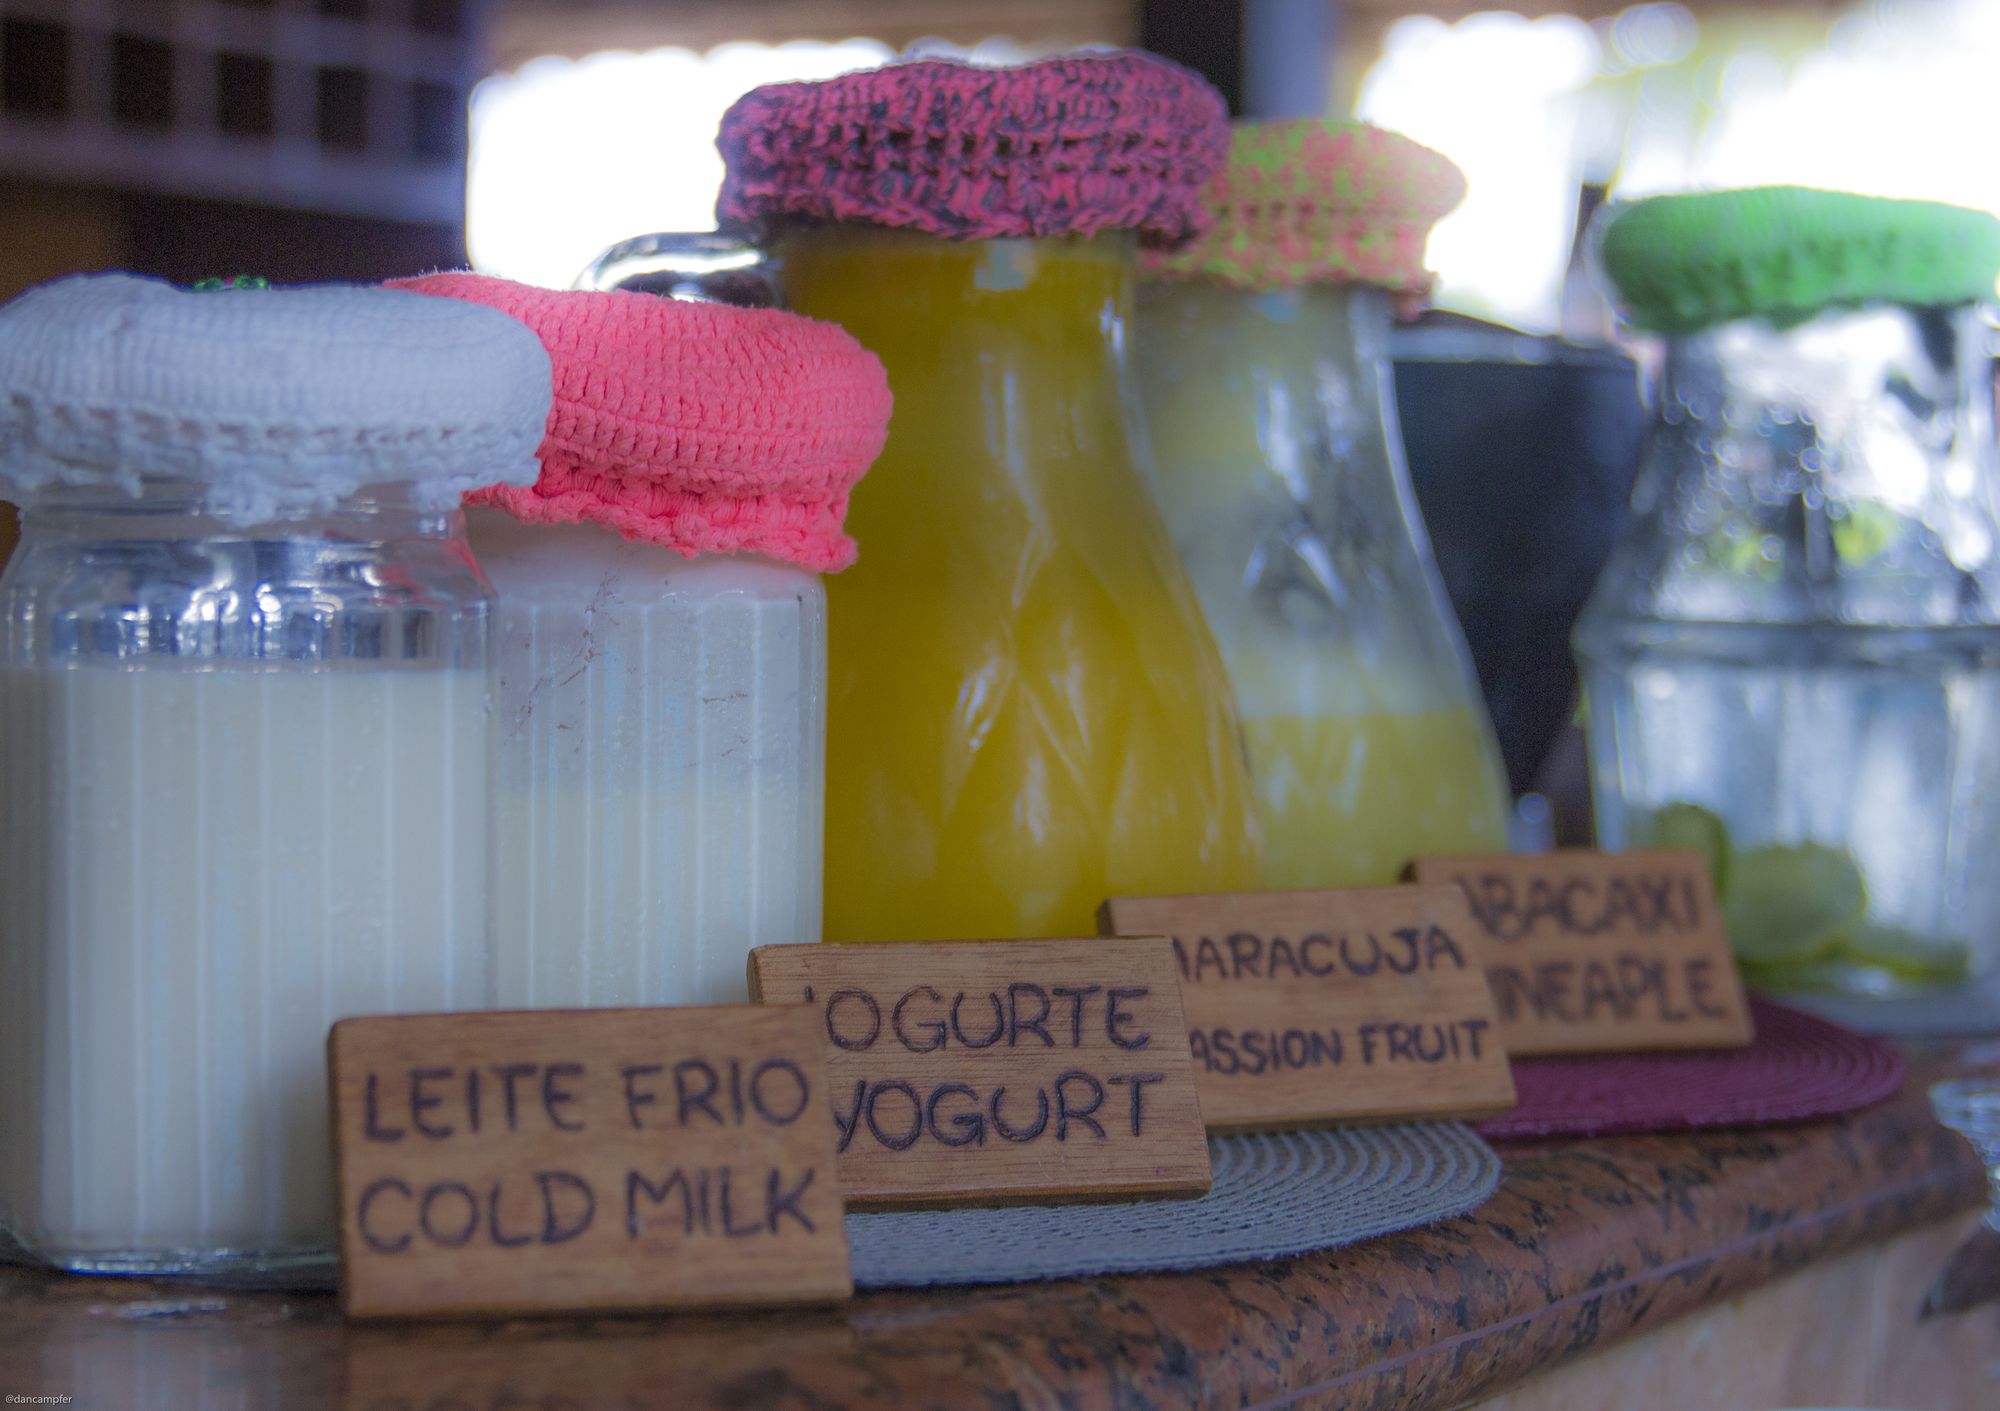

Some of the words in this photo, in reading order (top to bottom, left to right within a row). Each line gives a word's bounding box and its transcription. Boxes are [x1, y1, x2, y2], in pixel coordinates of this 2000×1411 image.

[804, 983, 1149, 1053] OGURTE
[1487, 955, 1728, 1024] NEAPLE
[1189, 1028, 1343, 1076] ASSION
[1358, 1019, 1490, 1066] FRUIT
[364, 1062, 584, 1142] LEITE
[620, 1057, 809, 1129] FRIO
[834, 1072, 1164, 1153] YOGURT
[357, 1170, 595, 1253] COLD
[625, 1167, 816, 1238] MILK
